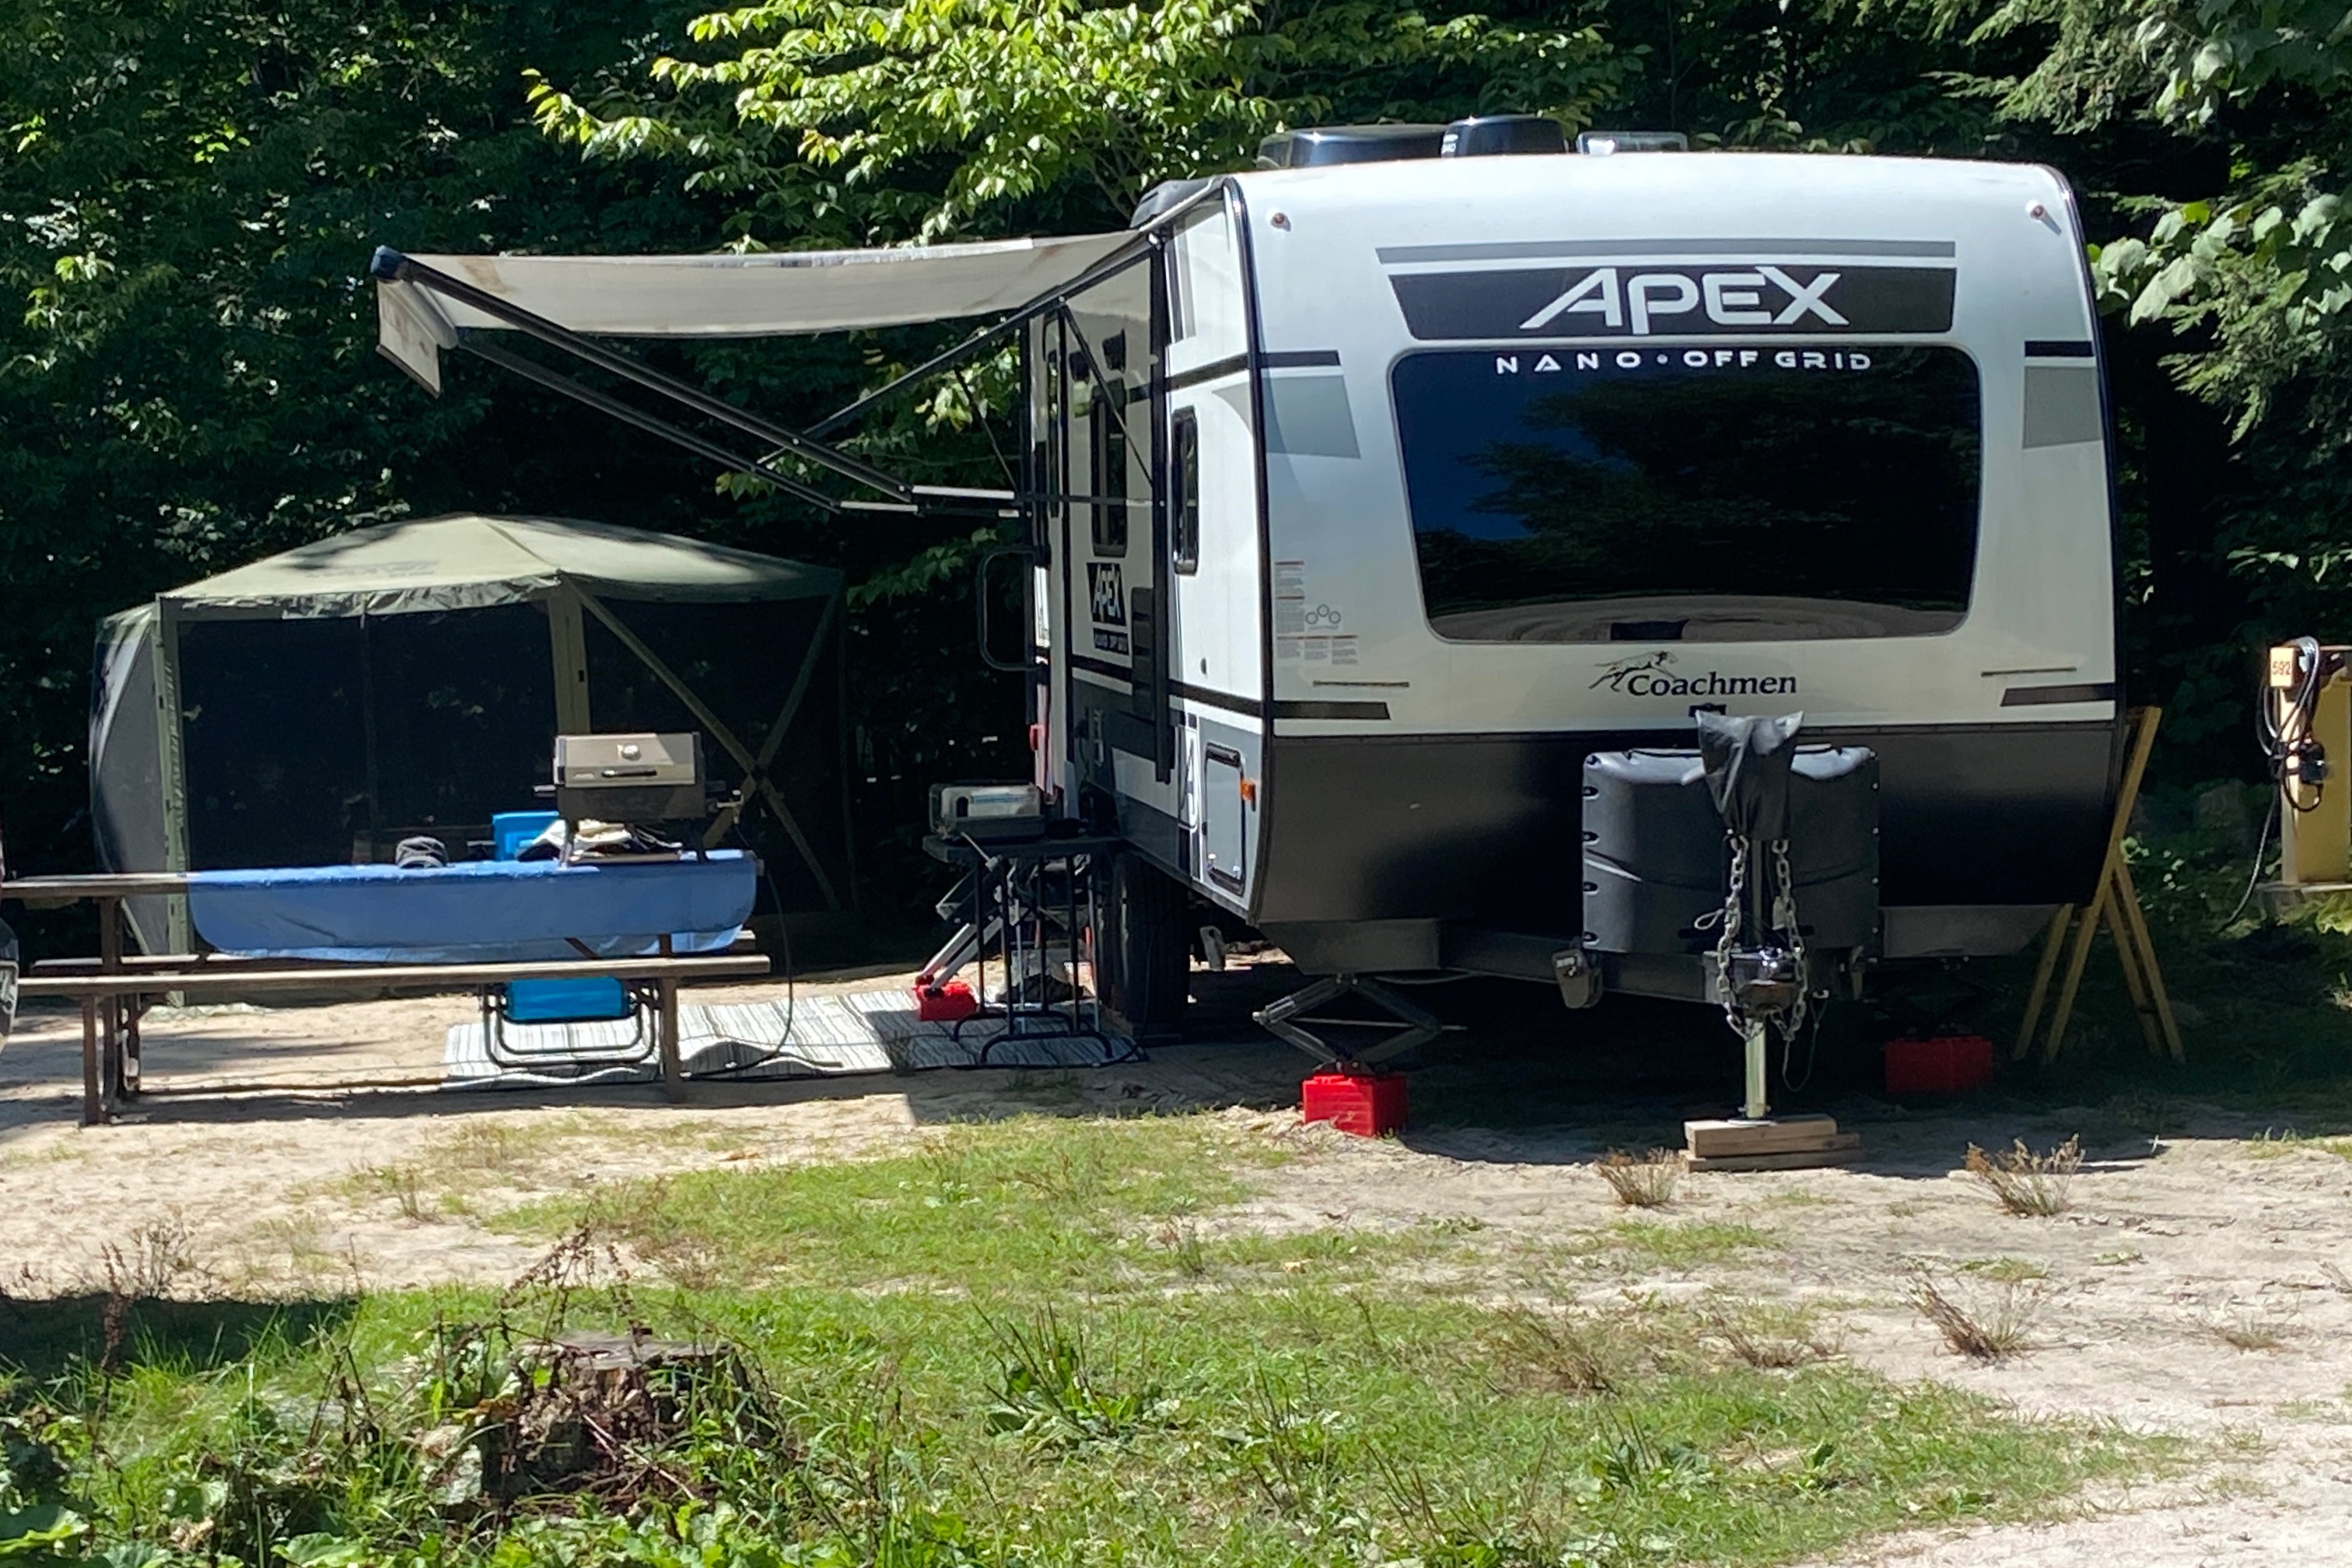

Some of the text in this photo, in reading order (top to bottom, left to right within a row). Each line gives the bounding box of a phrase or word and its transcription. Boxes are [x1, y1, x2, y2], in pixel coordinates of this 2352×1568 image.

[1519, 266, 1850, 334] APEX
[1496, 350, 1871, 374] NANO OFF GRID
[1093, 563, 1121, 622] APEX
[1627, 671, 1797, 696] Coachmen
